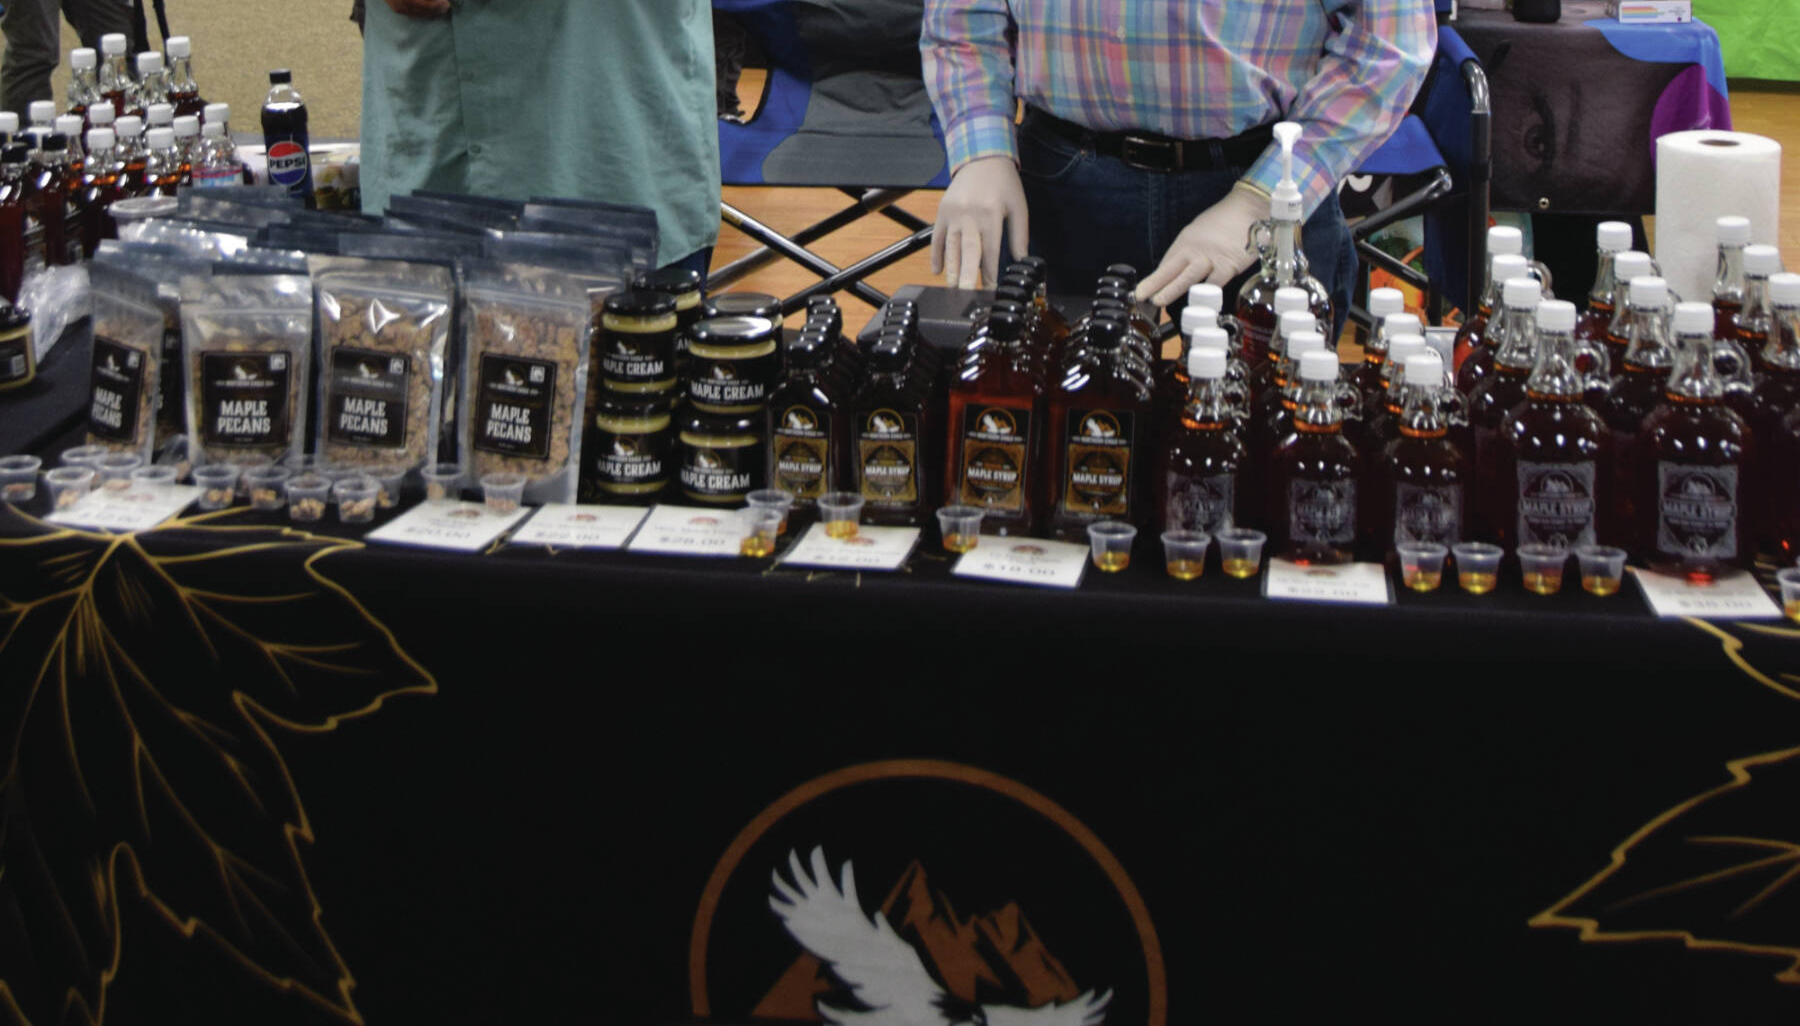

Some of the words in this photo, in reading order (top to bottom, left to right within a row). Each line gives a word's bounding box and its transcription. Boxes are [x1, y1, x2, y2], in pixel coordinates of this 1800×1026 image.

[269, 157, 306, 169] PEPSI
[626, 360, 664, 376] CREAM
[95, 385, 123, 411] MAPLE
[691, 380, 724, 399] MAPLE
[725, 382, 764, 400] CREAM
[221, 399, 268, 417] MAPLE
[344, 396, 386, 417] MAPLE
[491, 403, 531, 425] MAPLE
[217, 417, 271, 434] PECANS
[340, 413, 388, 436] PECANS
[486, 421, 532, 444] PECANS
[624, 461, 661, 477] CREAM
[778, 460, 800, 472] MAPLE
[801, 461, 823, 473] SYRUP
[865, 464, 888, 475] MAPLE
[888, 464, 911, 476] SYRUP
[967, 466, 992, 480] MAPLE
[993, 468, 1018, 482] SYRUP
[708, 472, 751, 490] CREAM
[1072, 471, 1097, 485] MAPLE
[1098, 473, 1123, 486] SYRUP
[1520, 500, 1556, 515] MAPLE
[1661, 502, 1696, 517] MAPLE
